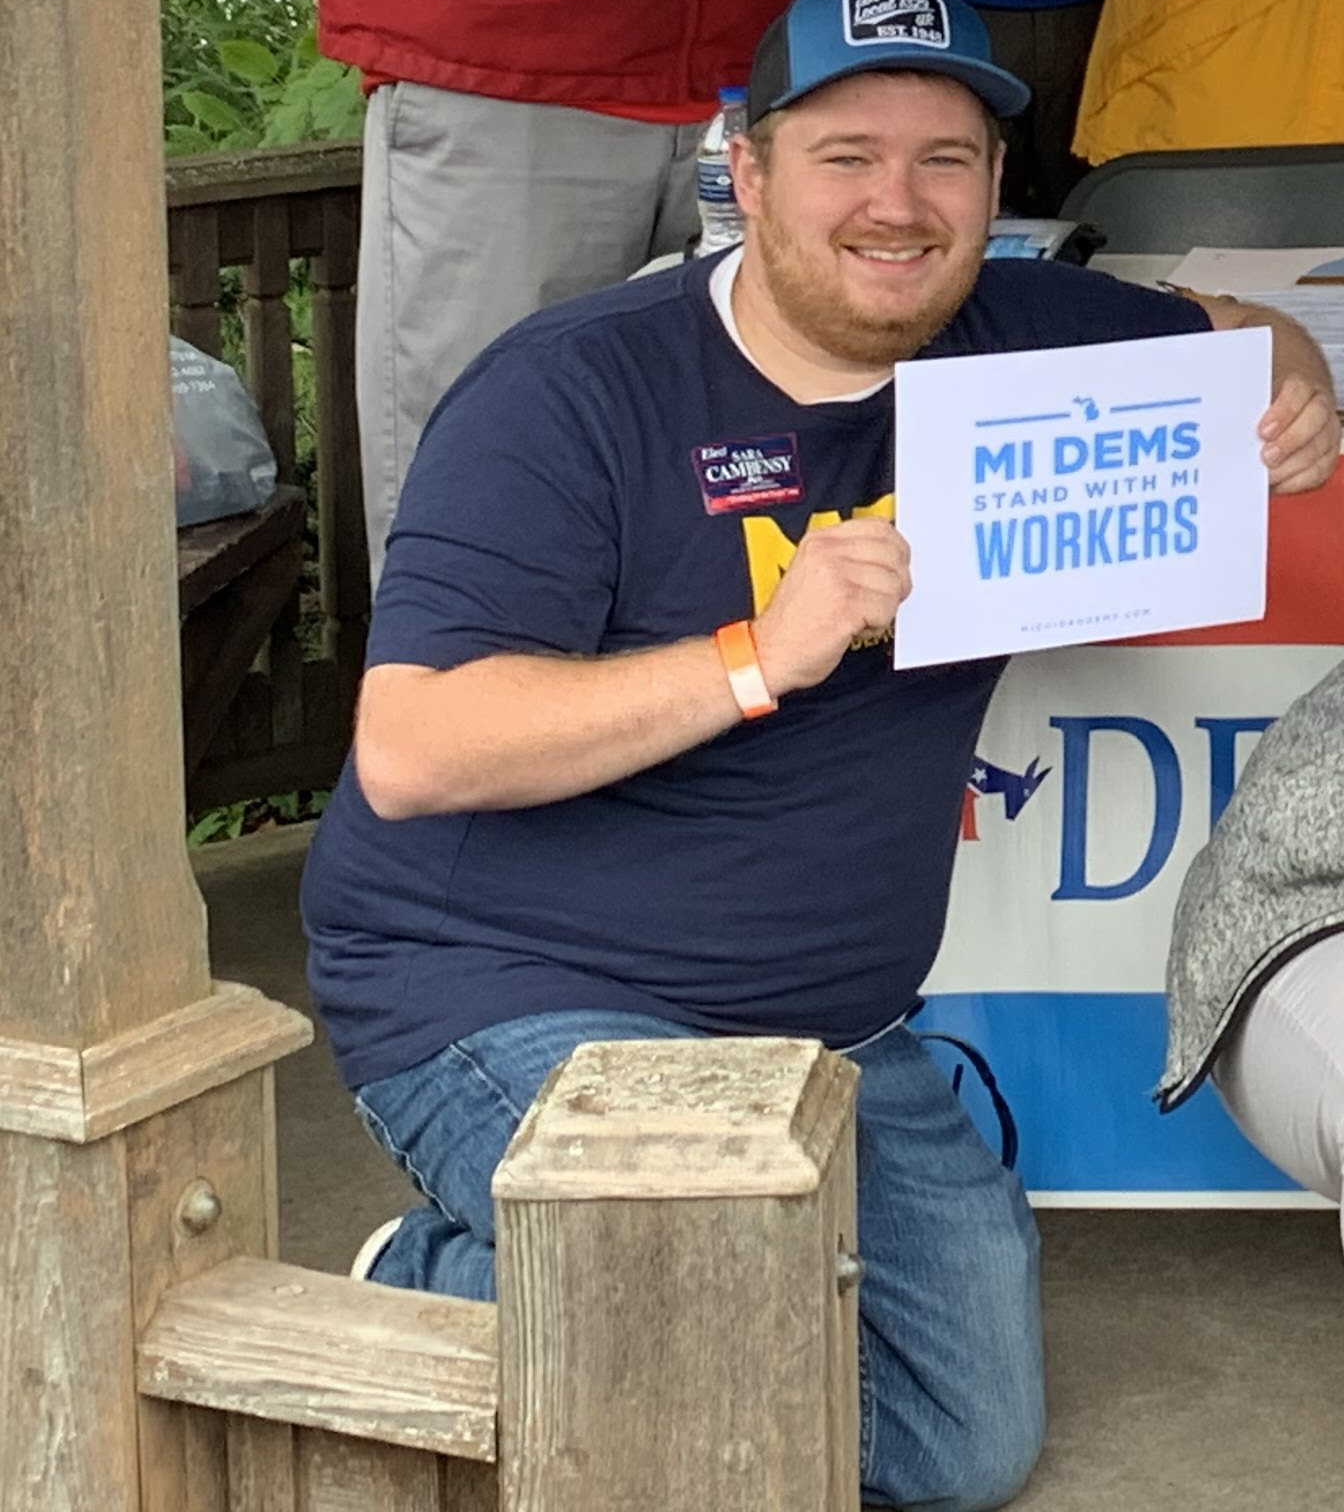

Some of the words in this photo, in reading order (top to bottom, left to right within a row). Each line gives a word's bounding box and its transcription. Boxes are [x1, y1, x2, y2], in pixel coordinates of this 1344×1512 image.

[876, 25, 909, 37] EST.
[975, 441, 1032, 484] MI
[1054, 422, 1200, 476] DEMS
[974, 490, 1067, 511] STAND
[1086, 476, 1156, 496] WITH
[1172, 469, 1198, 485] MI
[975, 496, 1198, 579] WORKERS
